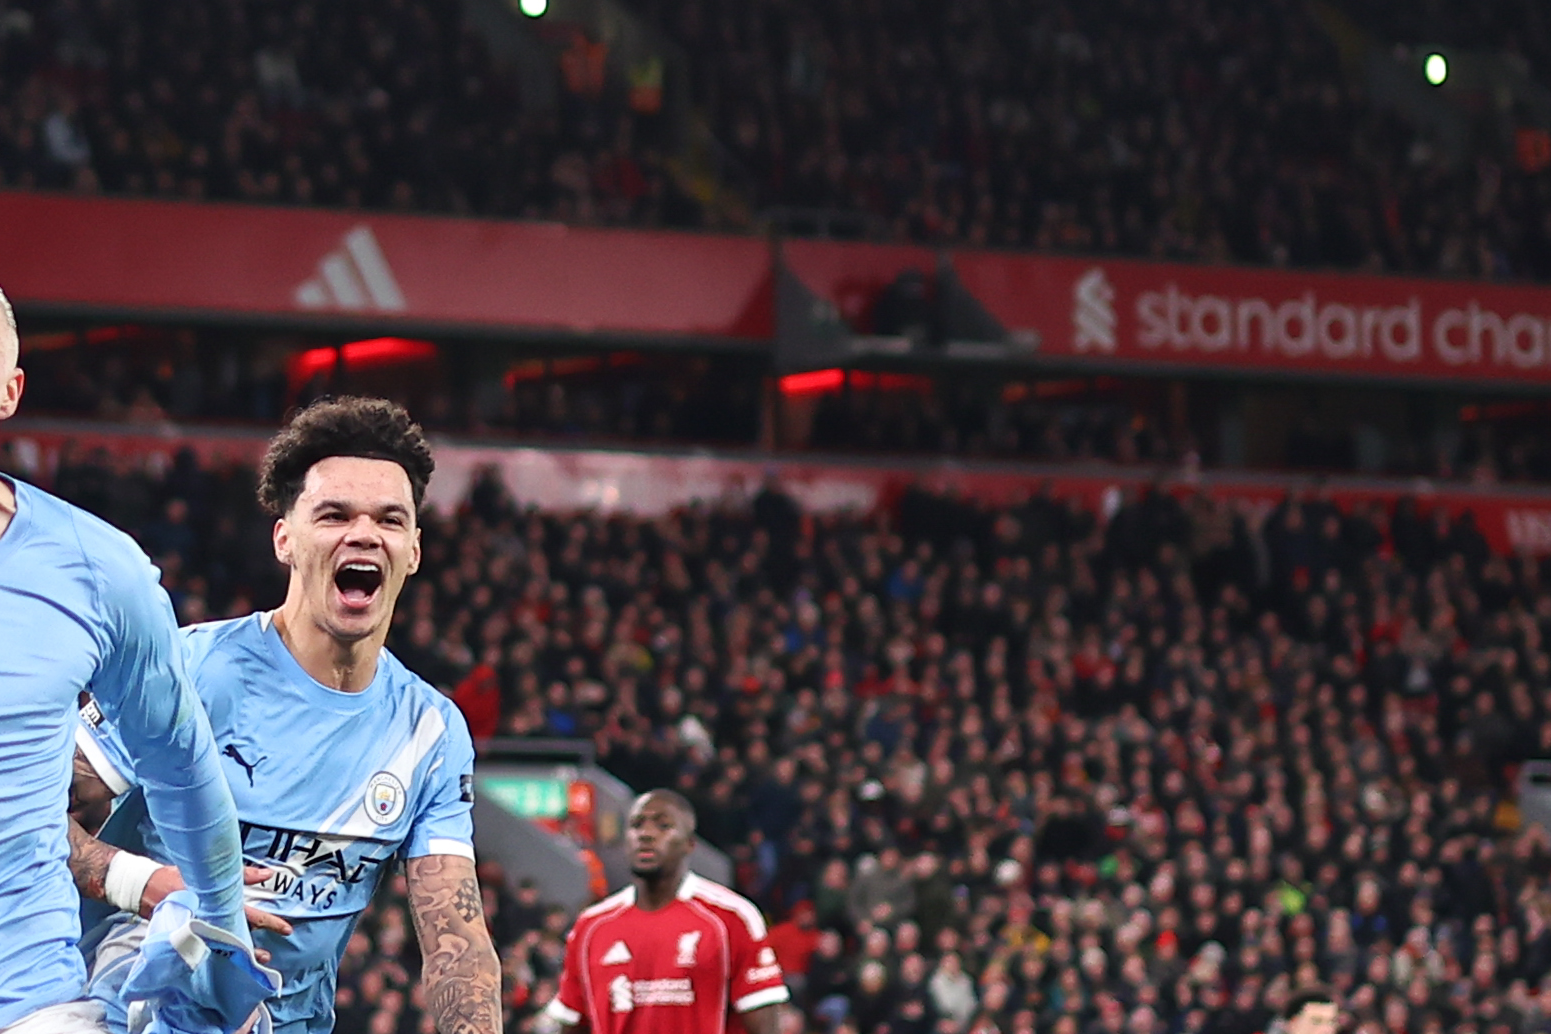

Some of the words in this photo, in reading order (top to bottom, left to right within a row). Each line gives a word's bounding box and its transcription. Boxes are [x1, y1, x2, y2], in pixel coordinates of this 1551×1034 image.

[1134, 282, 1423, 361] standard
[1432, 300, 1551, 368] cha
[260, 871, 338, 910] WAYS
